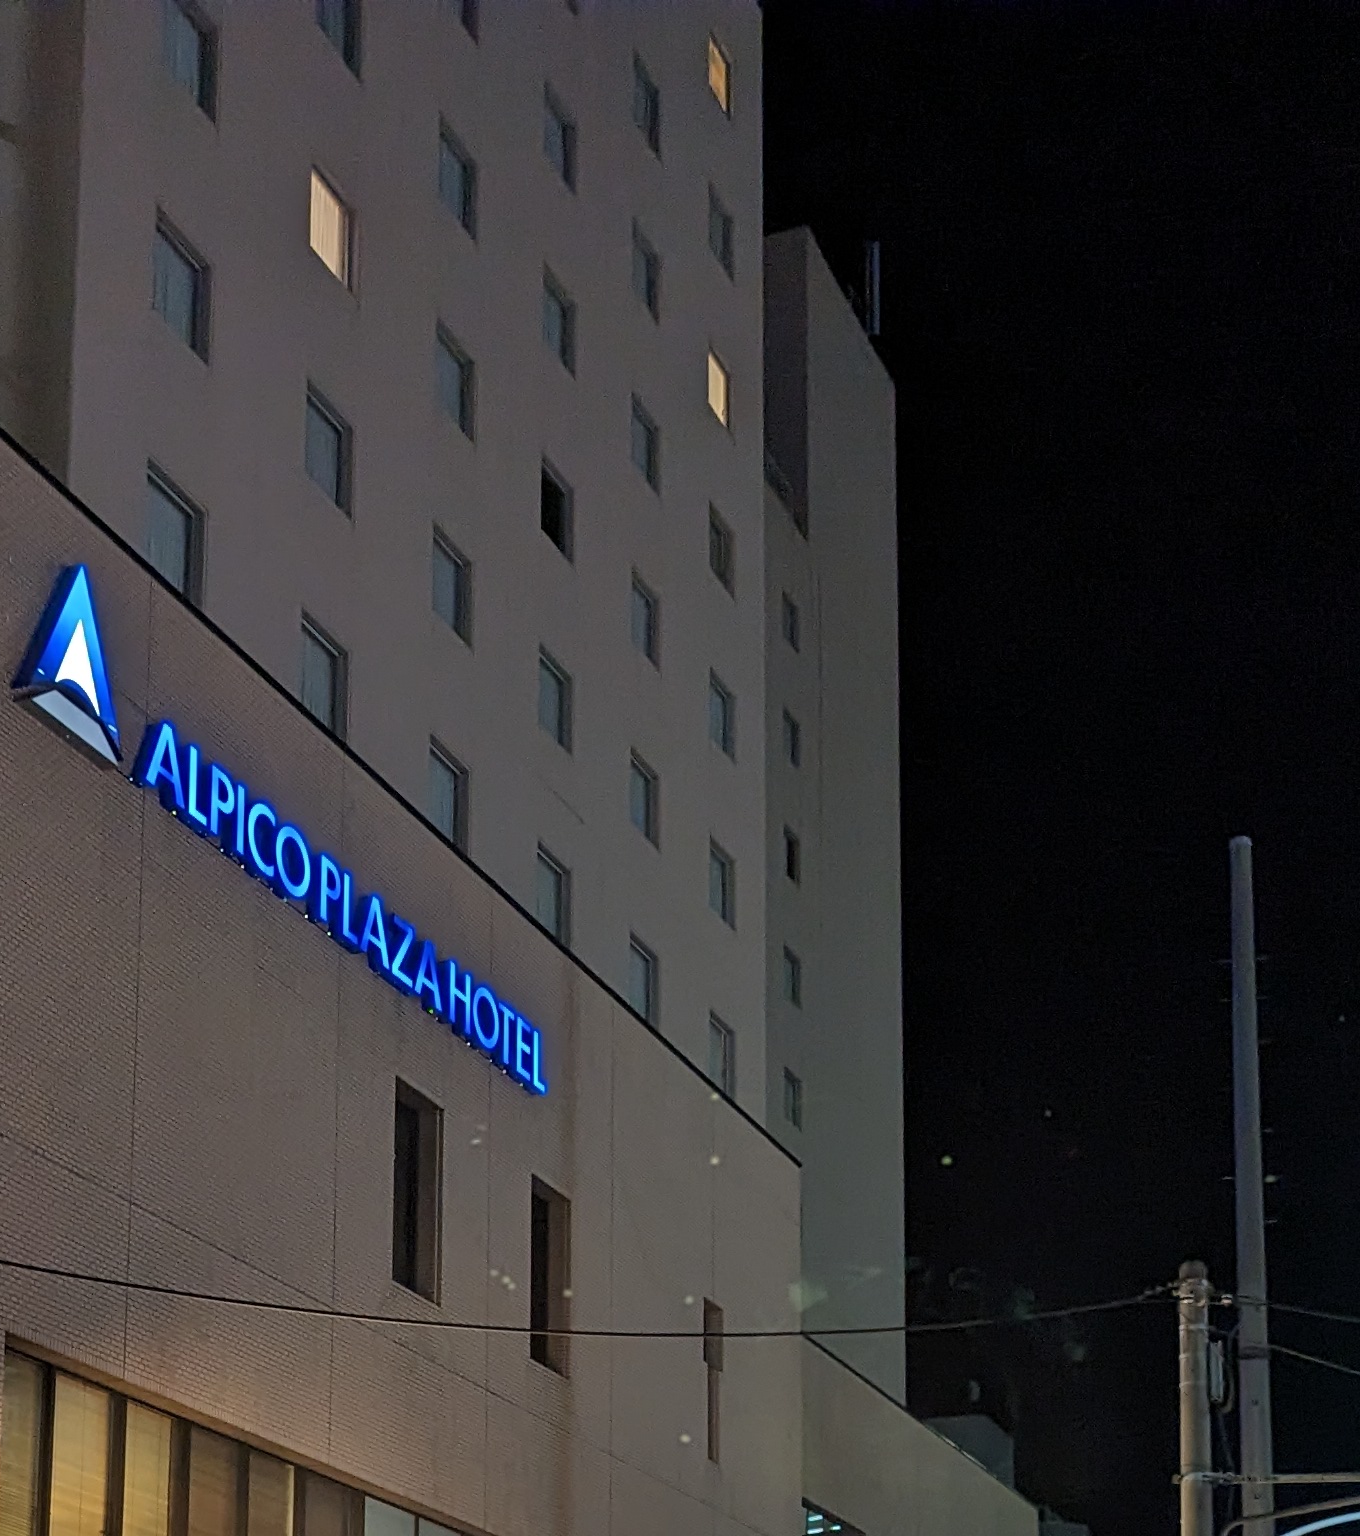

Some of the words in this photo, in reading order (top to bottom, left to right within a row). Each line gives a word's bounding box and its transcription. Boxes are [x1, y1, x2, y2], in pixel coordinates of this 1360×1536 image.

[143, 719, 313, 902] ALPICO
[318, 853, 442, 1015] PLAZA
[447, 959, 549, 1095] HOTEL
